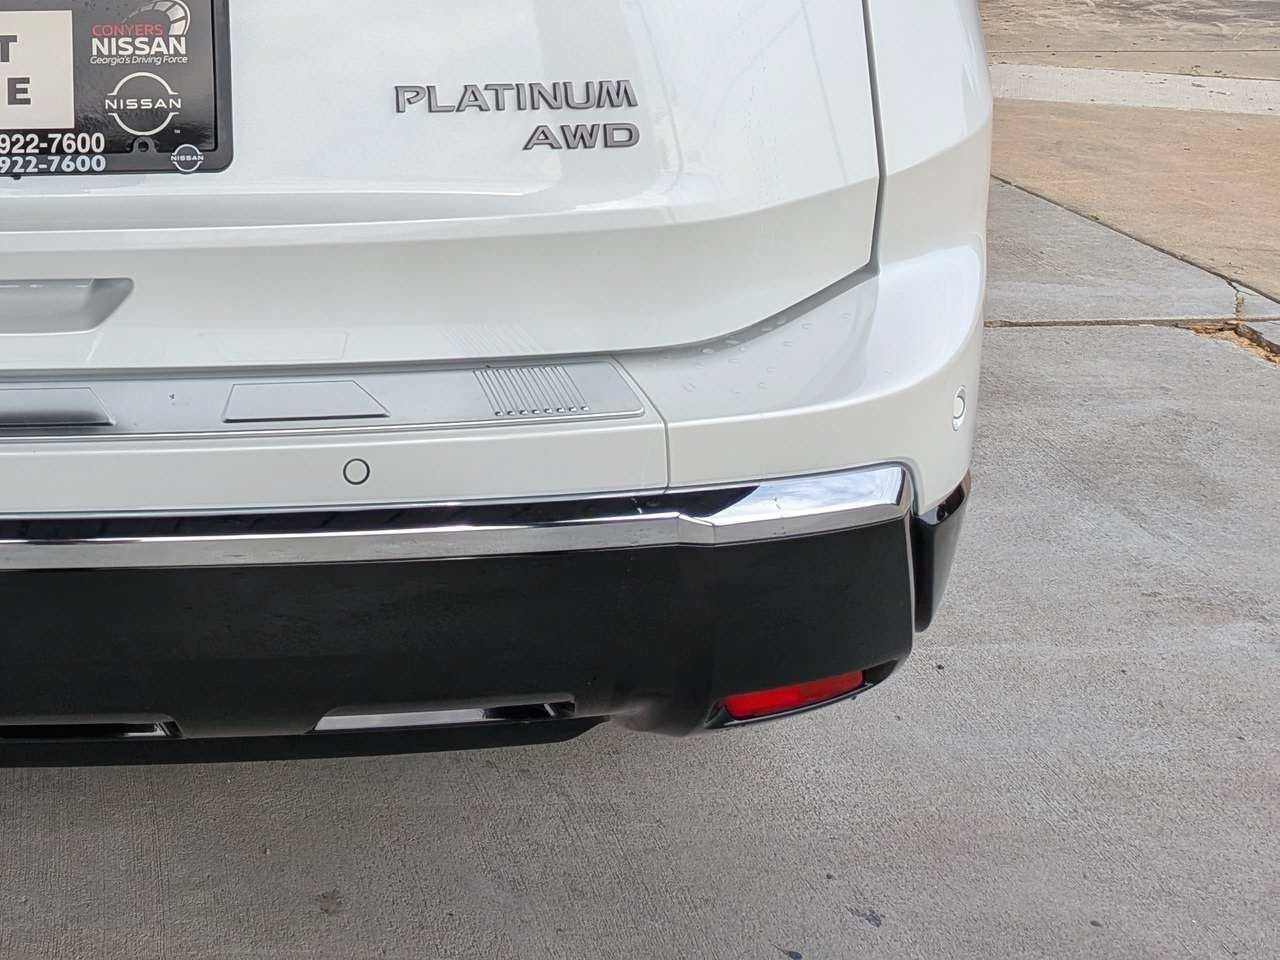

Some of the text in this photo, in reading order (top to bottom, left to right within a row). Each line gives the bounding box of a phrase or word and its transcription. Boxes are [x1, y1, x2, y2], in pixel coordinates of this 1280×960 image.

[91, 24, 164, 36] CONYERS
[91, 36, 187, 56] NISSAN
[89, 55, 188, 66] Georgia's Driving Force
[104, 98, 182, 110] NISSAN
[394, 80, 638, 113] PLATINUM
[522, 123, 640, 150] AWD
